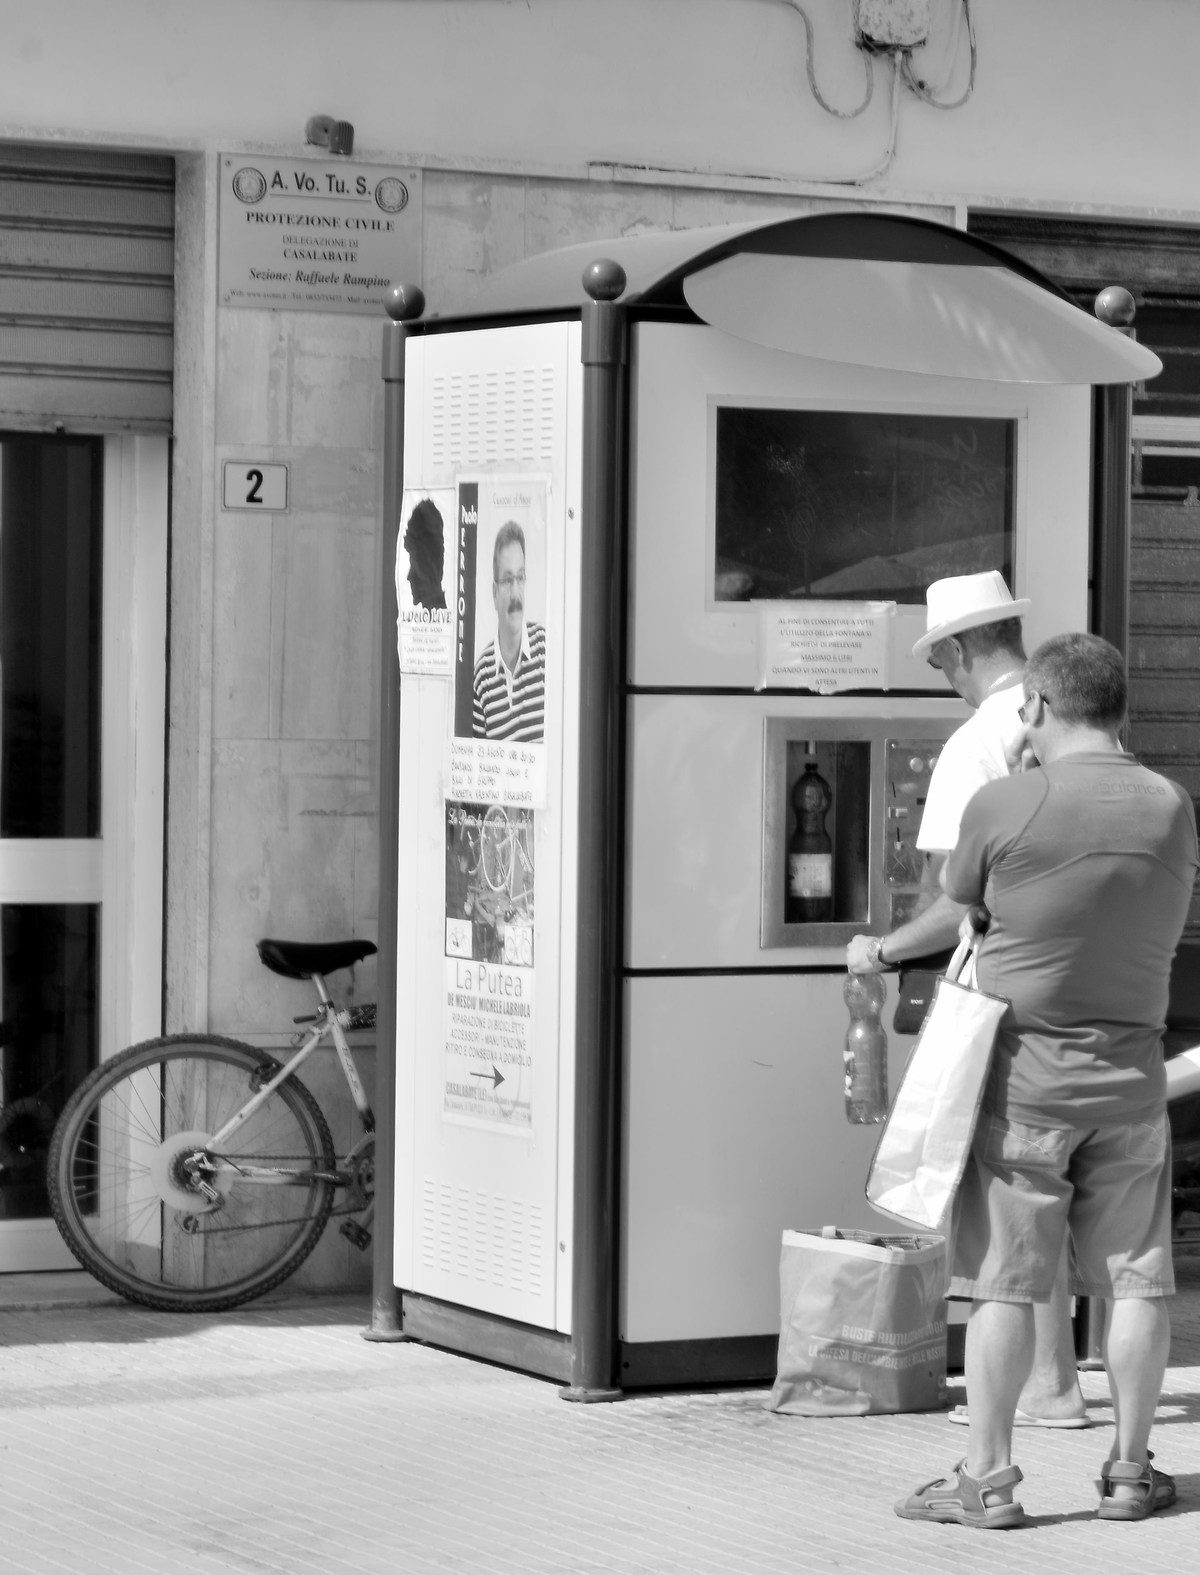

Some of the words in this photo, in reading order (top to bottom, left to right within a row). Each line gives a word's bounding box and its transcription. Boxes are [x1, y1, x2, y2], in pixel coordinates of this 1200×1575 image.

[271, 170, 288, 190] A.
[294, 171, 319, 192] Vo.
[325, 173, 350, 194] Tu.
[356, 175, 371, 196] S.
[246, 211, 341, 228] PROTEZIONE
[345, 217, 395, 231] CIVILE
[282, 234, 347, 248] DELEGAZIONE
[349, 239, 359, 248] DI
[283, 248, 357, 263] CASALABATE
[249, 267, 291, 281] Sezione:
[295, 270, 340, 286] Raffaele
[343, 273, 391, 288] Rampino
[246, 468, 263, 503] 2
[461, 504, 477, 525] Paolo
[456, 960, 472, 990] La
[478, 963, 522, 997] Putea
[478, 996, 502, 1015] MICHELE
[503, 1001, 531, 1019] LABRIOLA
[841, 1324, 876, 1343] BUSTE
